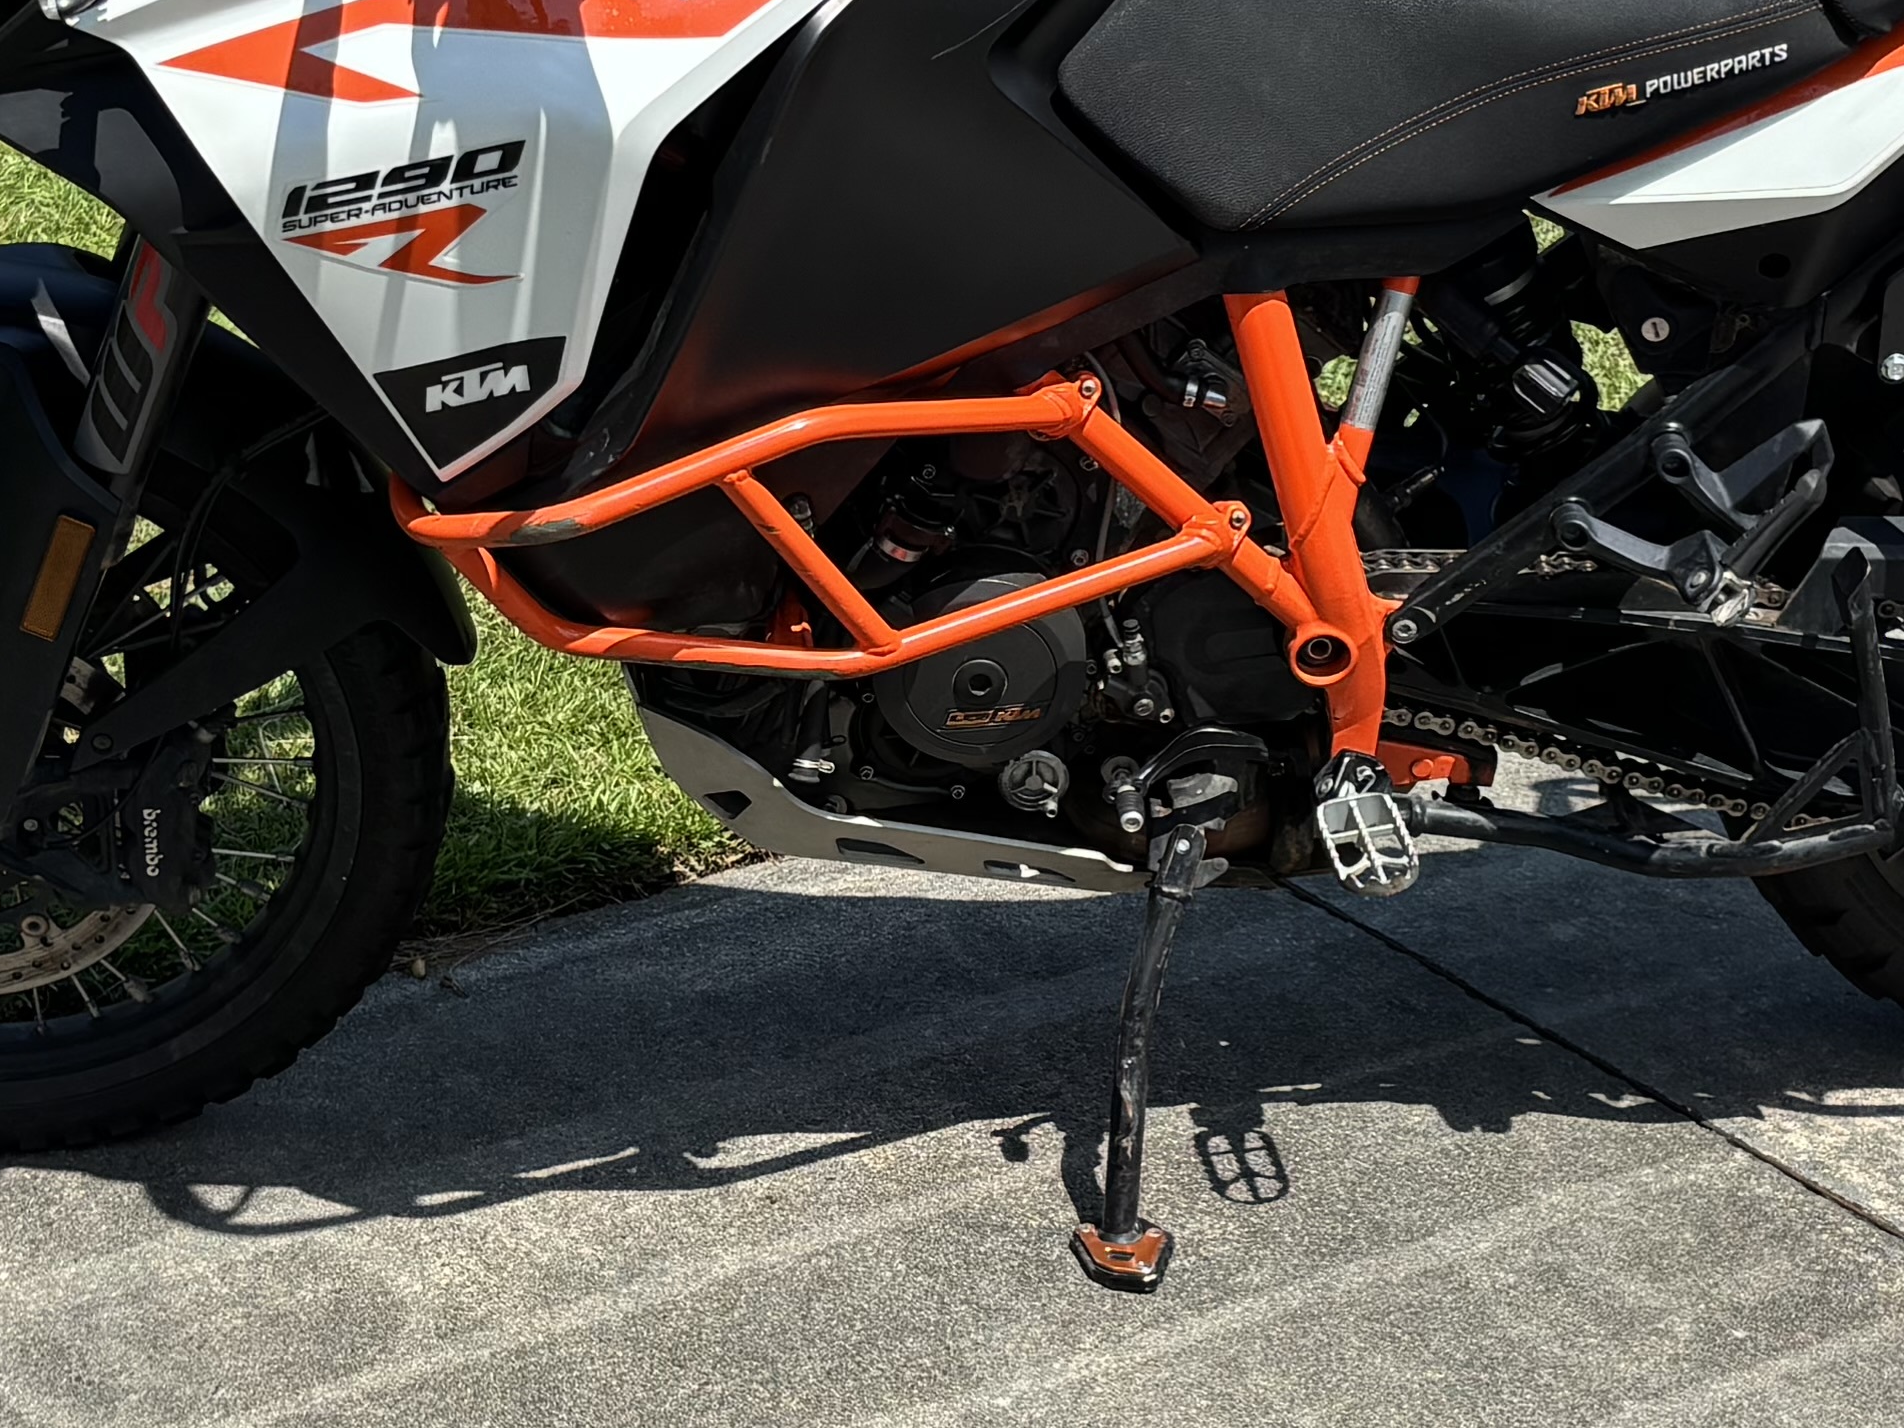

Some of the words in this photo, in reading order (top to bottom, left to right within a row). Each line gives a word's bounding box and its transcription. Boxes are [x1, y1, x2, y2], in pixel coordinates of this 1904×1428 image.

[1574, 81, 1639, 117] KTM
[1644, 44, 1789, 99] POWERPARTS
[281, 139, 527, 220] 1290
[281, 175, 519, 234] SUPER-ADVENTURE
[425, 362, 531, 413] KTM
[142, 808, 165, 877] brembo
